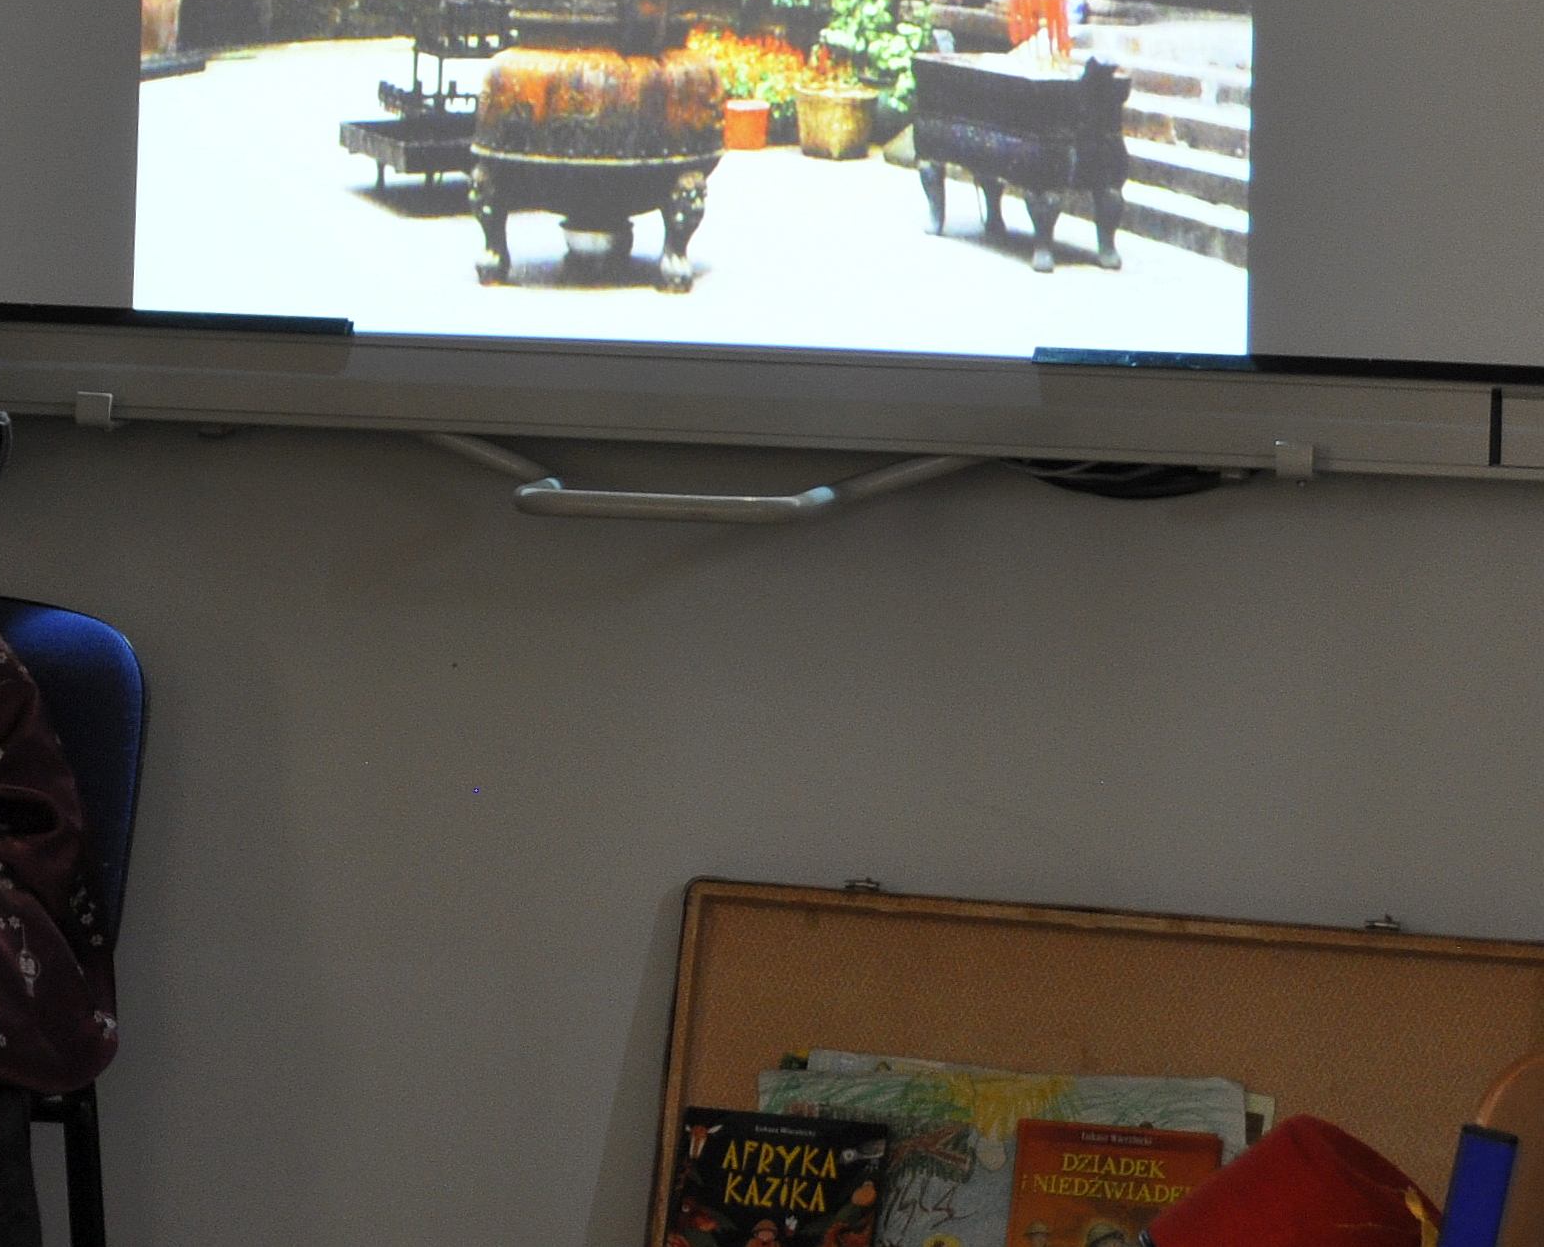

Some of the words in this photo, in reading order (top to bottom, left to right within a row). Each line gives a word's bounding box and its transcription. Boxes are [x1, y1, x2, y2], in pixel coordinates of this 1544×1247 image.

[722, 1138, 838, 1179] AFRYKA
[1062, 1153, 1166, 1178] DZIADEK
[1033, 1173, 1192, 1203] NIEDŹWIADE
